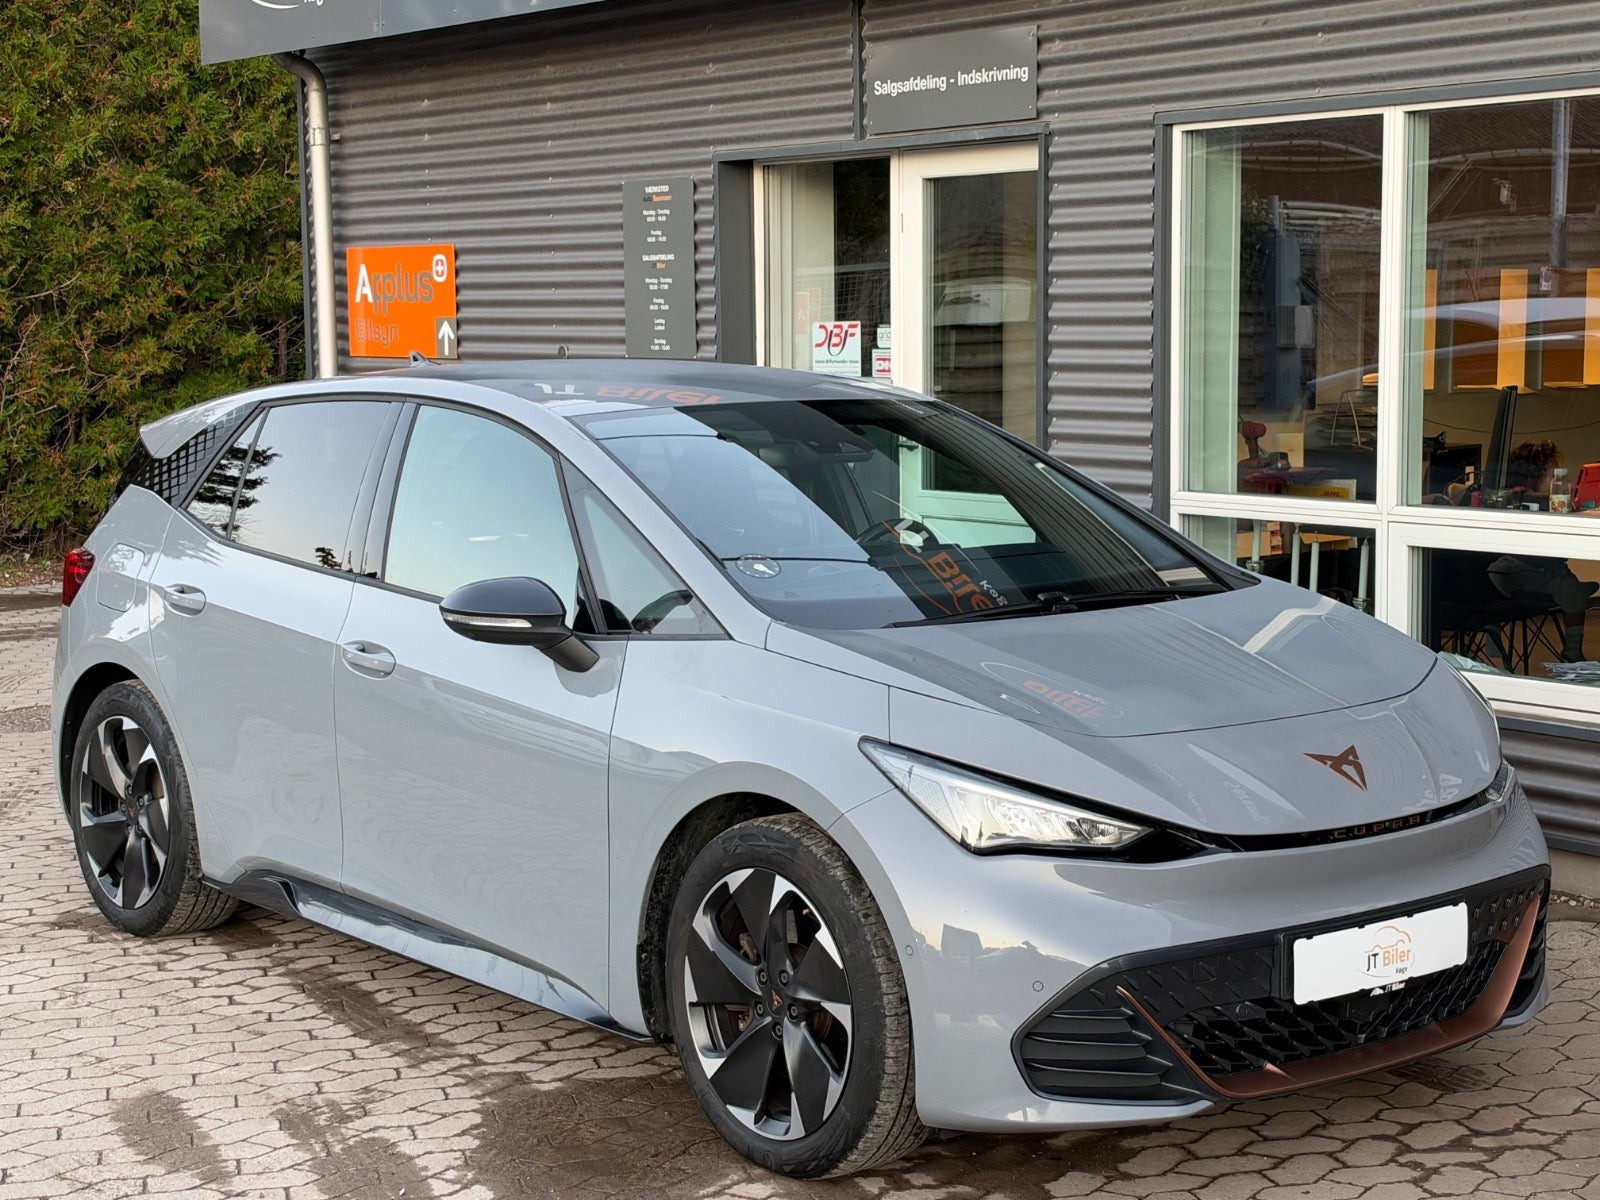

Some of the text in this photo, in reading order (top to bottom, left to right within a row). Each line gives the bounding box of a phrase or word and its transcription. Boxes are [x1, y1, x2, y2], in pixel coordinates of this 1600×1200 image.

[874, 75, 947, 97] Salgsafdeling
[957, 65, 1029, 86] Indskrivning
[356, 319, 399, 347] Bilsyn
[1333, 815, 1421, 839] CUPRA
[1366, 948, 1412, 972] JT Biler
